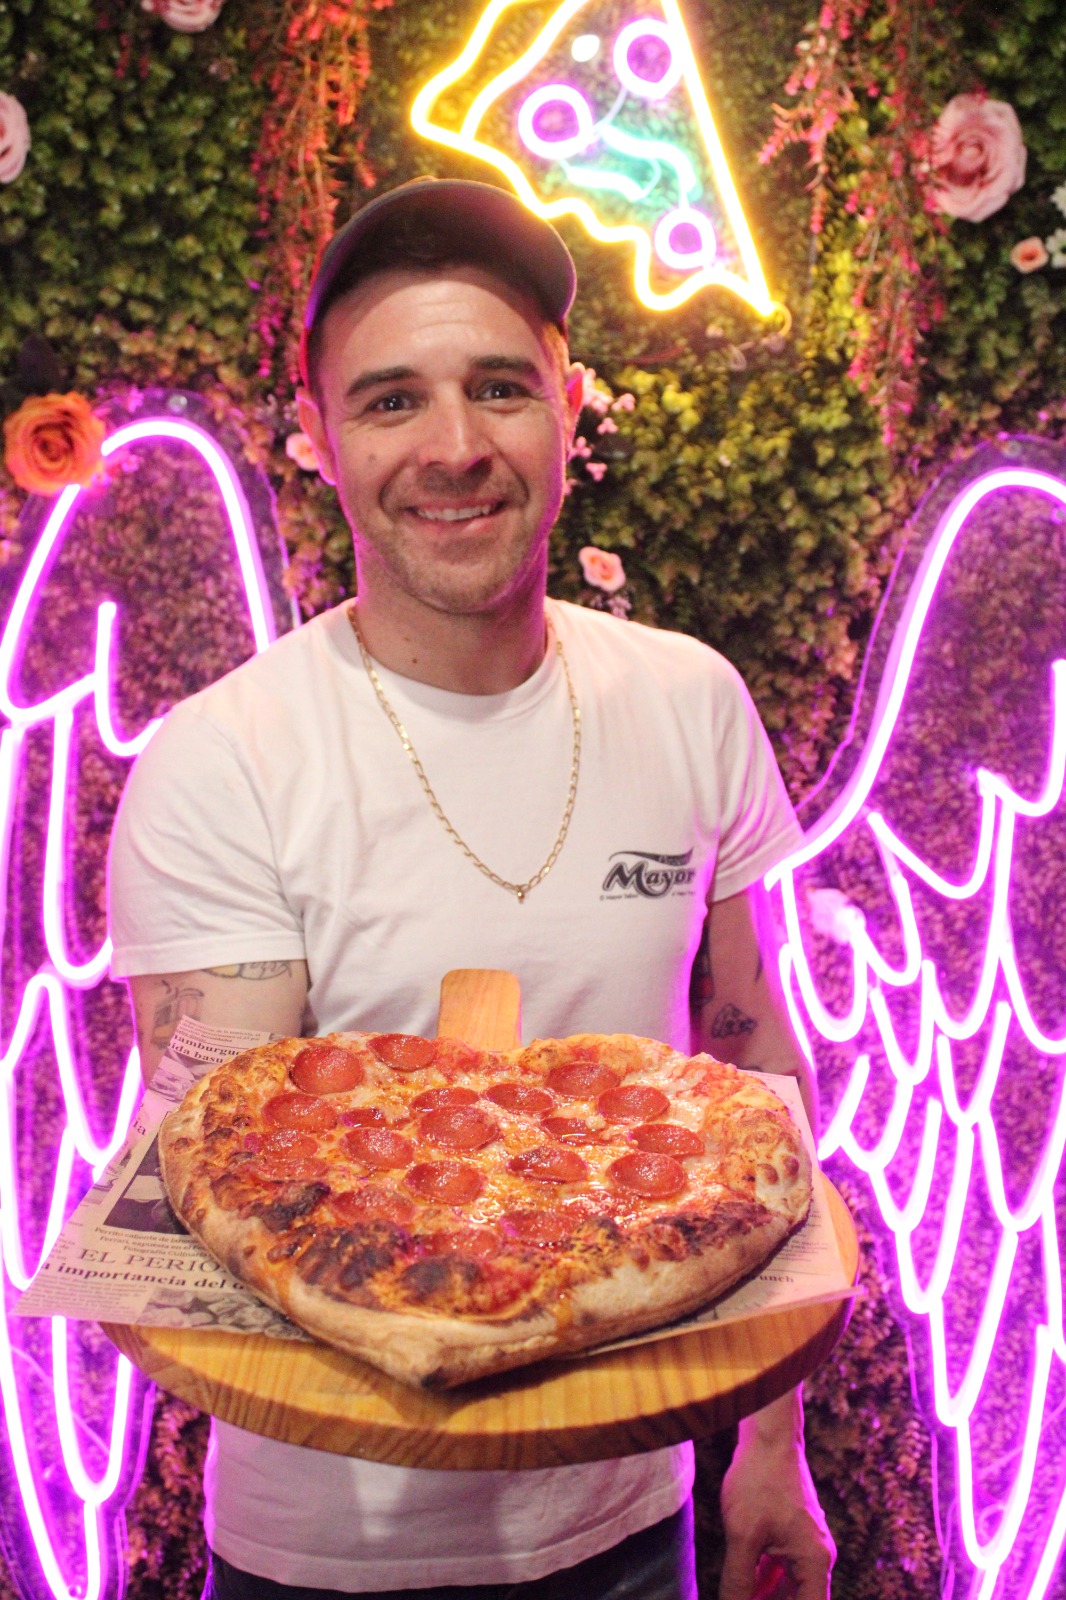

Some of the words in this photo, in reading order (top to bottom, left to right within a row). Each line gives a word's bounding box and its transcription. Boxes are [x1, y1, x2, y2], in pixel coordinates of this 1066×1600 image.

[602, 861, 696, 899] Mayor
[168, 1042, 190, 1054] ida
[78, 1248, 116, 1263] EL
[125, 1254, 226, 1273] PERIÓ
[57, 1262, 186, 1286] importancia
[194, 1278, 226, 1289] del
